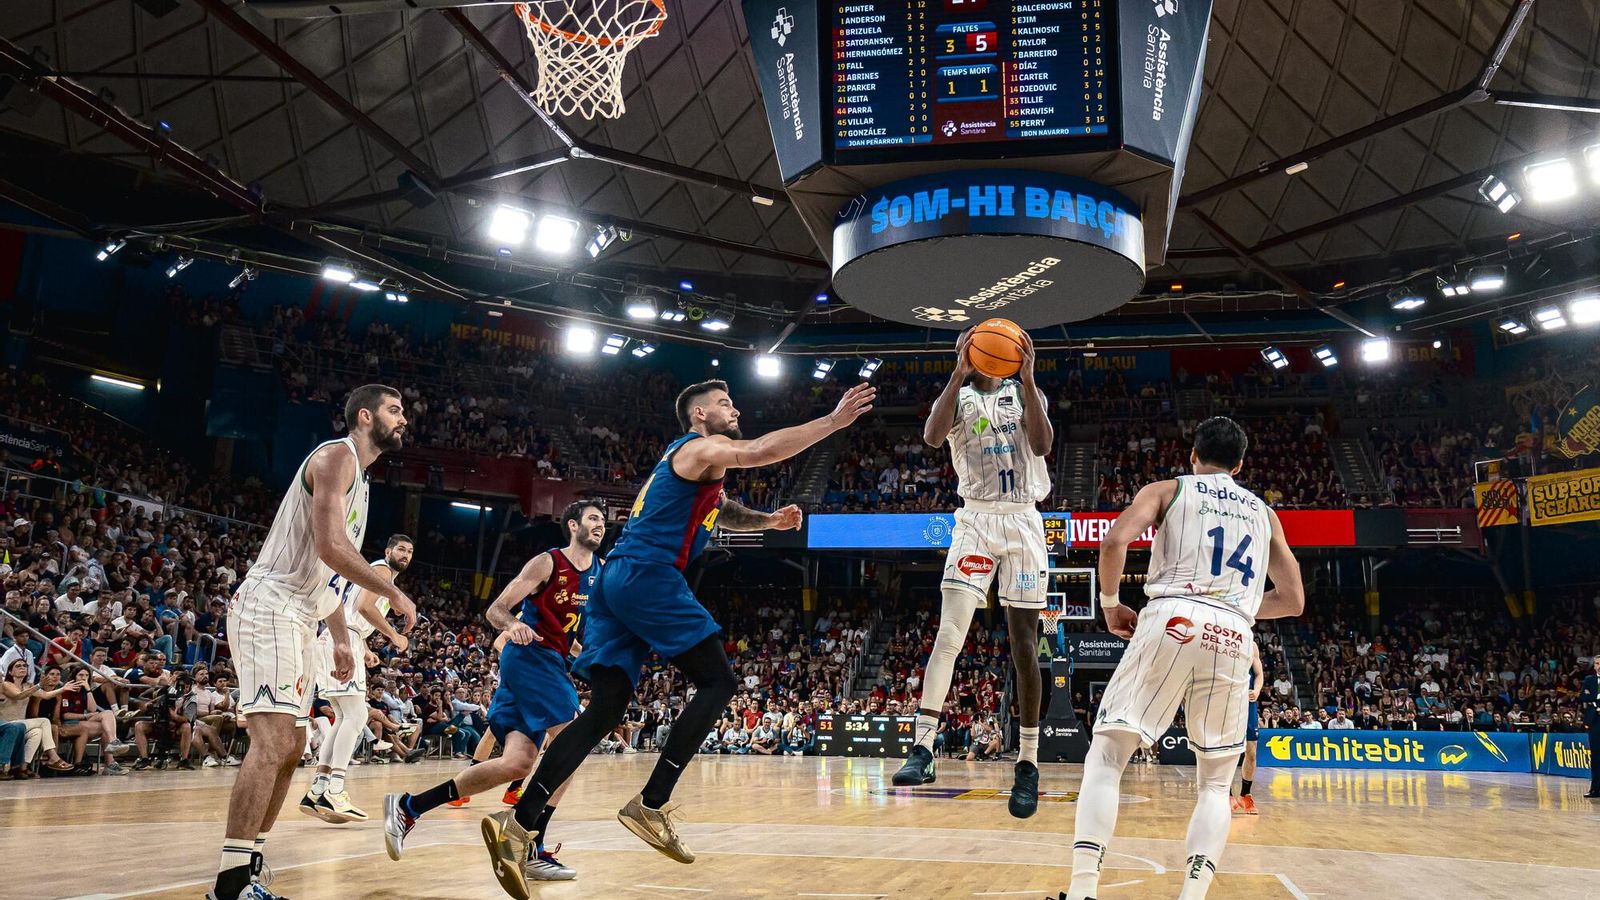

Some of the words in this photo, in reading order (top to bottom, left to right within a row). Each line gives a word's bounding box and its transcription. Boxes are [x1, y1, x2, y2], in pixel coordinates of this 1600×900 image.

[1017, 2, 1072, 12] BALCEROWSKI
[845, 16, 885, 24] ANDERSON
[846, 27, 882, 35] BRIZUELA
[1018, 26, 1059, 35] KALINOSKI
[846, 37, 894, 47] SATORANSKY
[946, 40, 955, 52] 3
[976, 35, 987, 51] 5
[846, 48, 903, 58] HERNANGÓMEZ
[1018, 50, 1057, 58] BARREIRO
[1143, 24, 1160, 88] Sanitària
[970, 66, 990, 75] MORT
[1153, 28, 1170, 121] Assistència
[847, 72, 879, 80] ABRINES
[776, 57, 791, 120] Sanitària
[847, 84, 876, 92] PARKER
[948, 81, 955, 94] 1
[981, 79, 987, 92] 1
[1020, 84, 1057, 92] DJEDOVIC
[785, 53, 804, 140] Assistència
[1020, 107, 1054, 115] KRAVISH
[848, 128, 886, 136] GONZÁLEZ
[872, 186, 1015, 233] SOM-HI
[955, 256, 1061, 307] Assistència
[975, 278, 1055, 311] Sanitària
[998, 469, 1014, 494] 11
[1047, 531, 1064, 544] 24
[1207, 526, 1254, 586] 14
[1204, 623, 1242, 643] COSTA
[1202, 633, 1221, 644] DEL
[1079, 640, 1124, 648] Assistència
[1079, 648, 1111, 656] Sanitària
[845, 722, 869, 730] 5:34
[1296, 737, 1425, 762] whitebit
